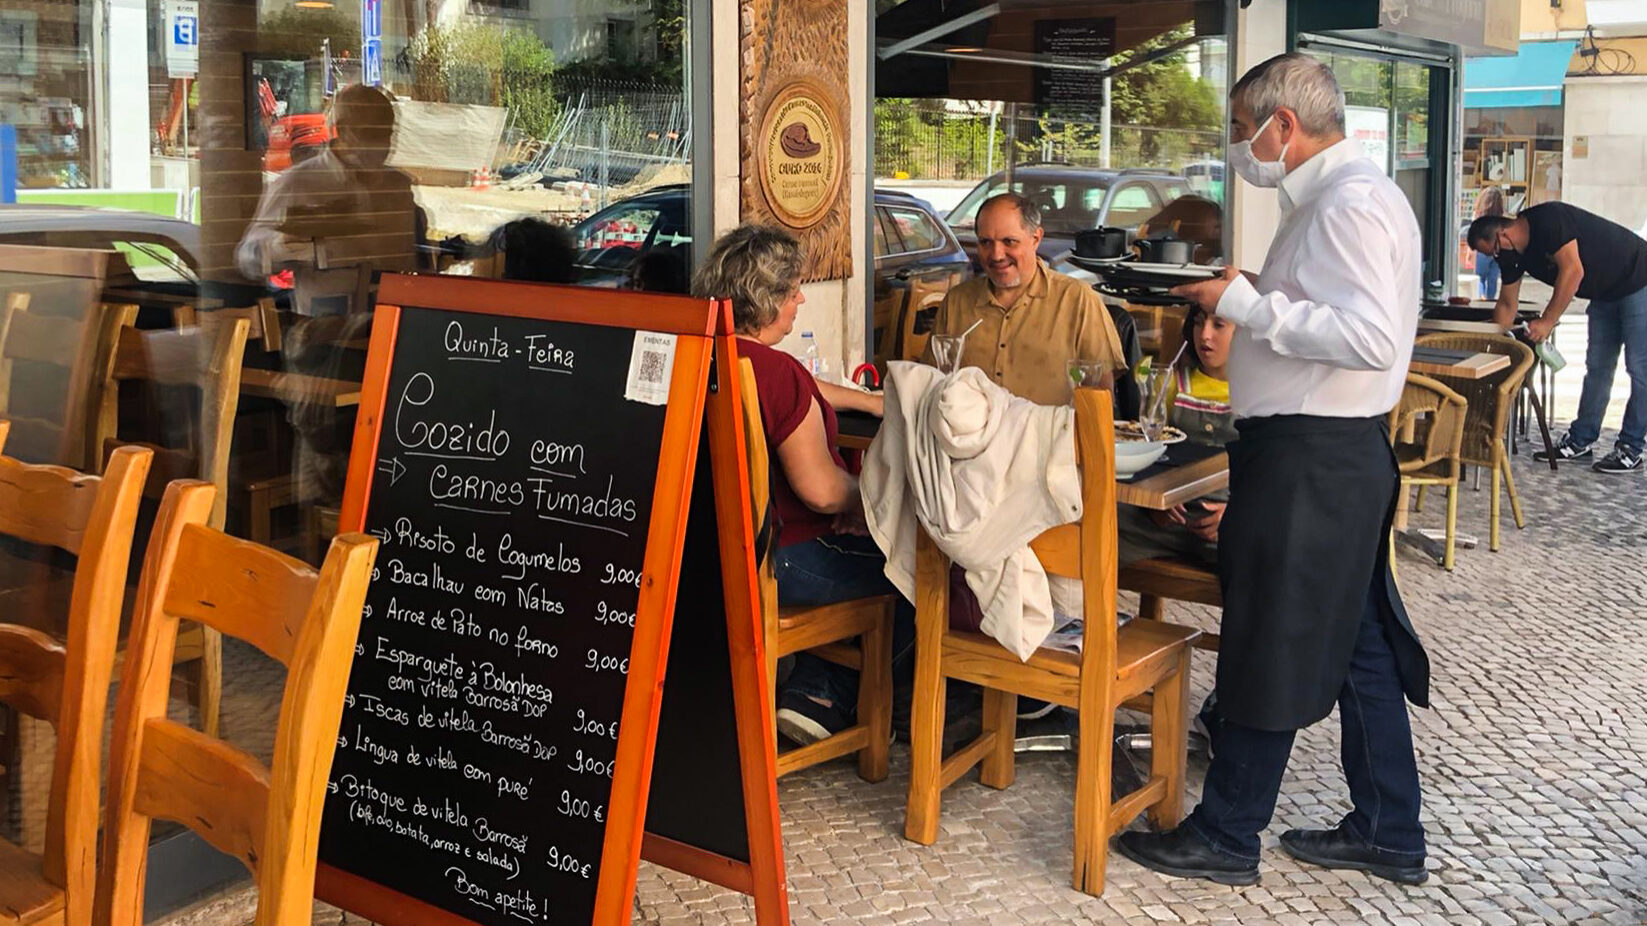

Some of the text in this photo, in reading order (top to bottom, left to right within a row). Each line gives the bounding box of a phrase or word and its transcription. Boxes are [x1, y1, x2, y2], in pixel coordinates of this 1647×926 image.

[444, 320, 509, 358] Quinta
[524, 334, 575, 369] Feira
[395, 372, 586, 474] Cozido com
[429, 463, 637, 522] Carnes Fumadas
[395, 517, 456, 555] Risoto
[466, 533, 486, 563] de
[499, 533, 582, 579] Cogumelos
[388, 559, 465, 594] Bacalhau
[474, 585, 506, 606] com
[518, 583, 565, 615] Natas
[387, 597, 629, 675] Arroz de Pato no forno 9,00€
[376, 637, 553, 704] Esparguete à Bolonhesa
[388, 674, 415, 694] com
[421, 676, 458, 699] vitela
[463, 686, 520, 712] Barrosã
[521, 700, 547, 718] DOP
[359, 693, 409, 727] Iscas
[418, 706, 434, 728] de
[438, 709, 478, 733] vitela
[481, 721, 532, 755] Barrosã
[533, 741, 557, 760] DOP
[407, 746, 421, 766] de
[426, 746, 458, 770] vitela
[463, 765, 492, 785] com
[498, 777, 533, 801] puré
[340, 774, 407, 820] Bitoque
[413, 797, 429, 817] de
[431, 799, 468, 828] vitela
[472, 818, 529, 853] Barrosã
[445, 868, 488, 900] Bom
[476, 849, 520, 880] salada)
